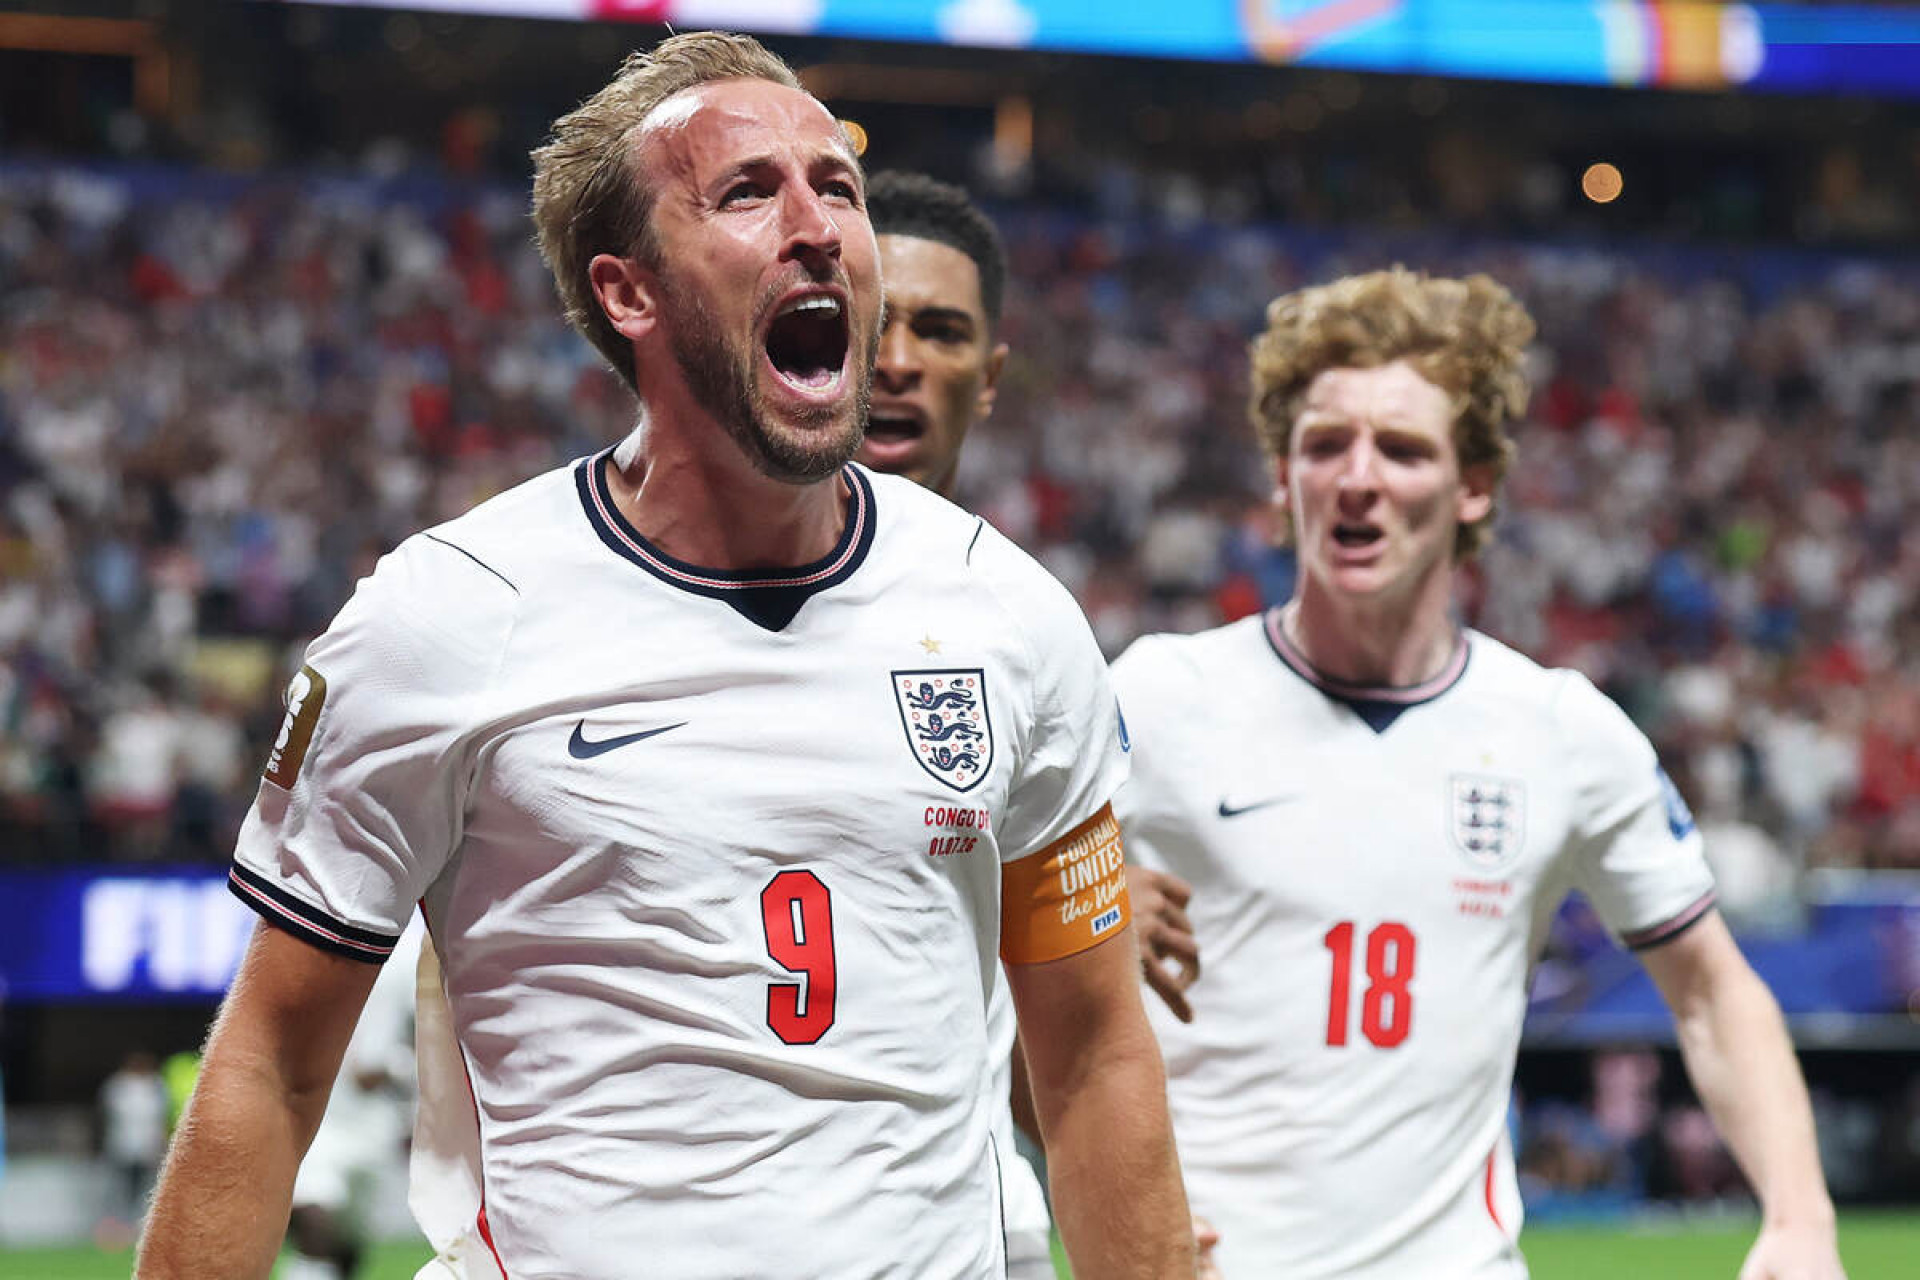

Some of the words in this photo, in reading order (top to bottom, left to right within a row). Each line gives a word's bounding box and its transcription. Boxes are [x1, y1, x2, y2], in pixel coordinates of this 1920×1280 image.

[924, 806, 976, 828] CONGO
[1060, 837, 1122, 895] UNITES
[82, 876, 258, 991] FIF
[1056, 896, 1093, 925] the
[1094, 908, 1119, 932] FIFA
[760, 869, 837, 1045] 9
[1323, 920, 1417, 1048] 18
